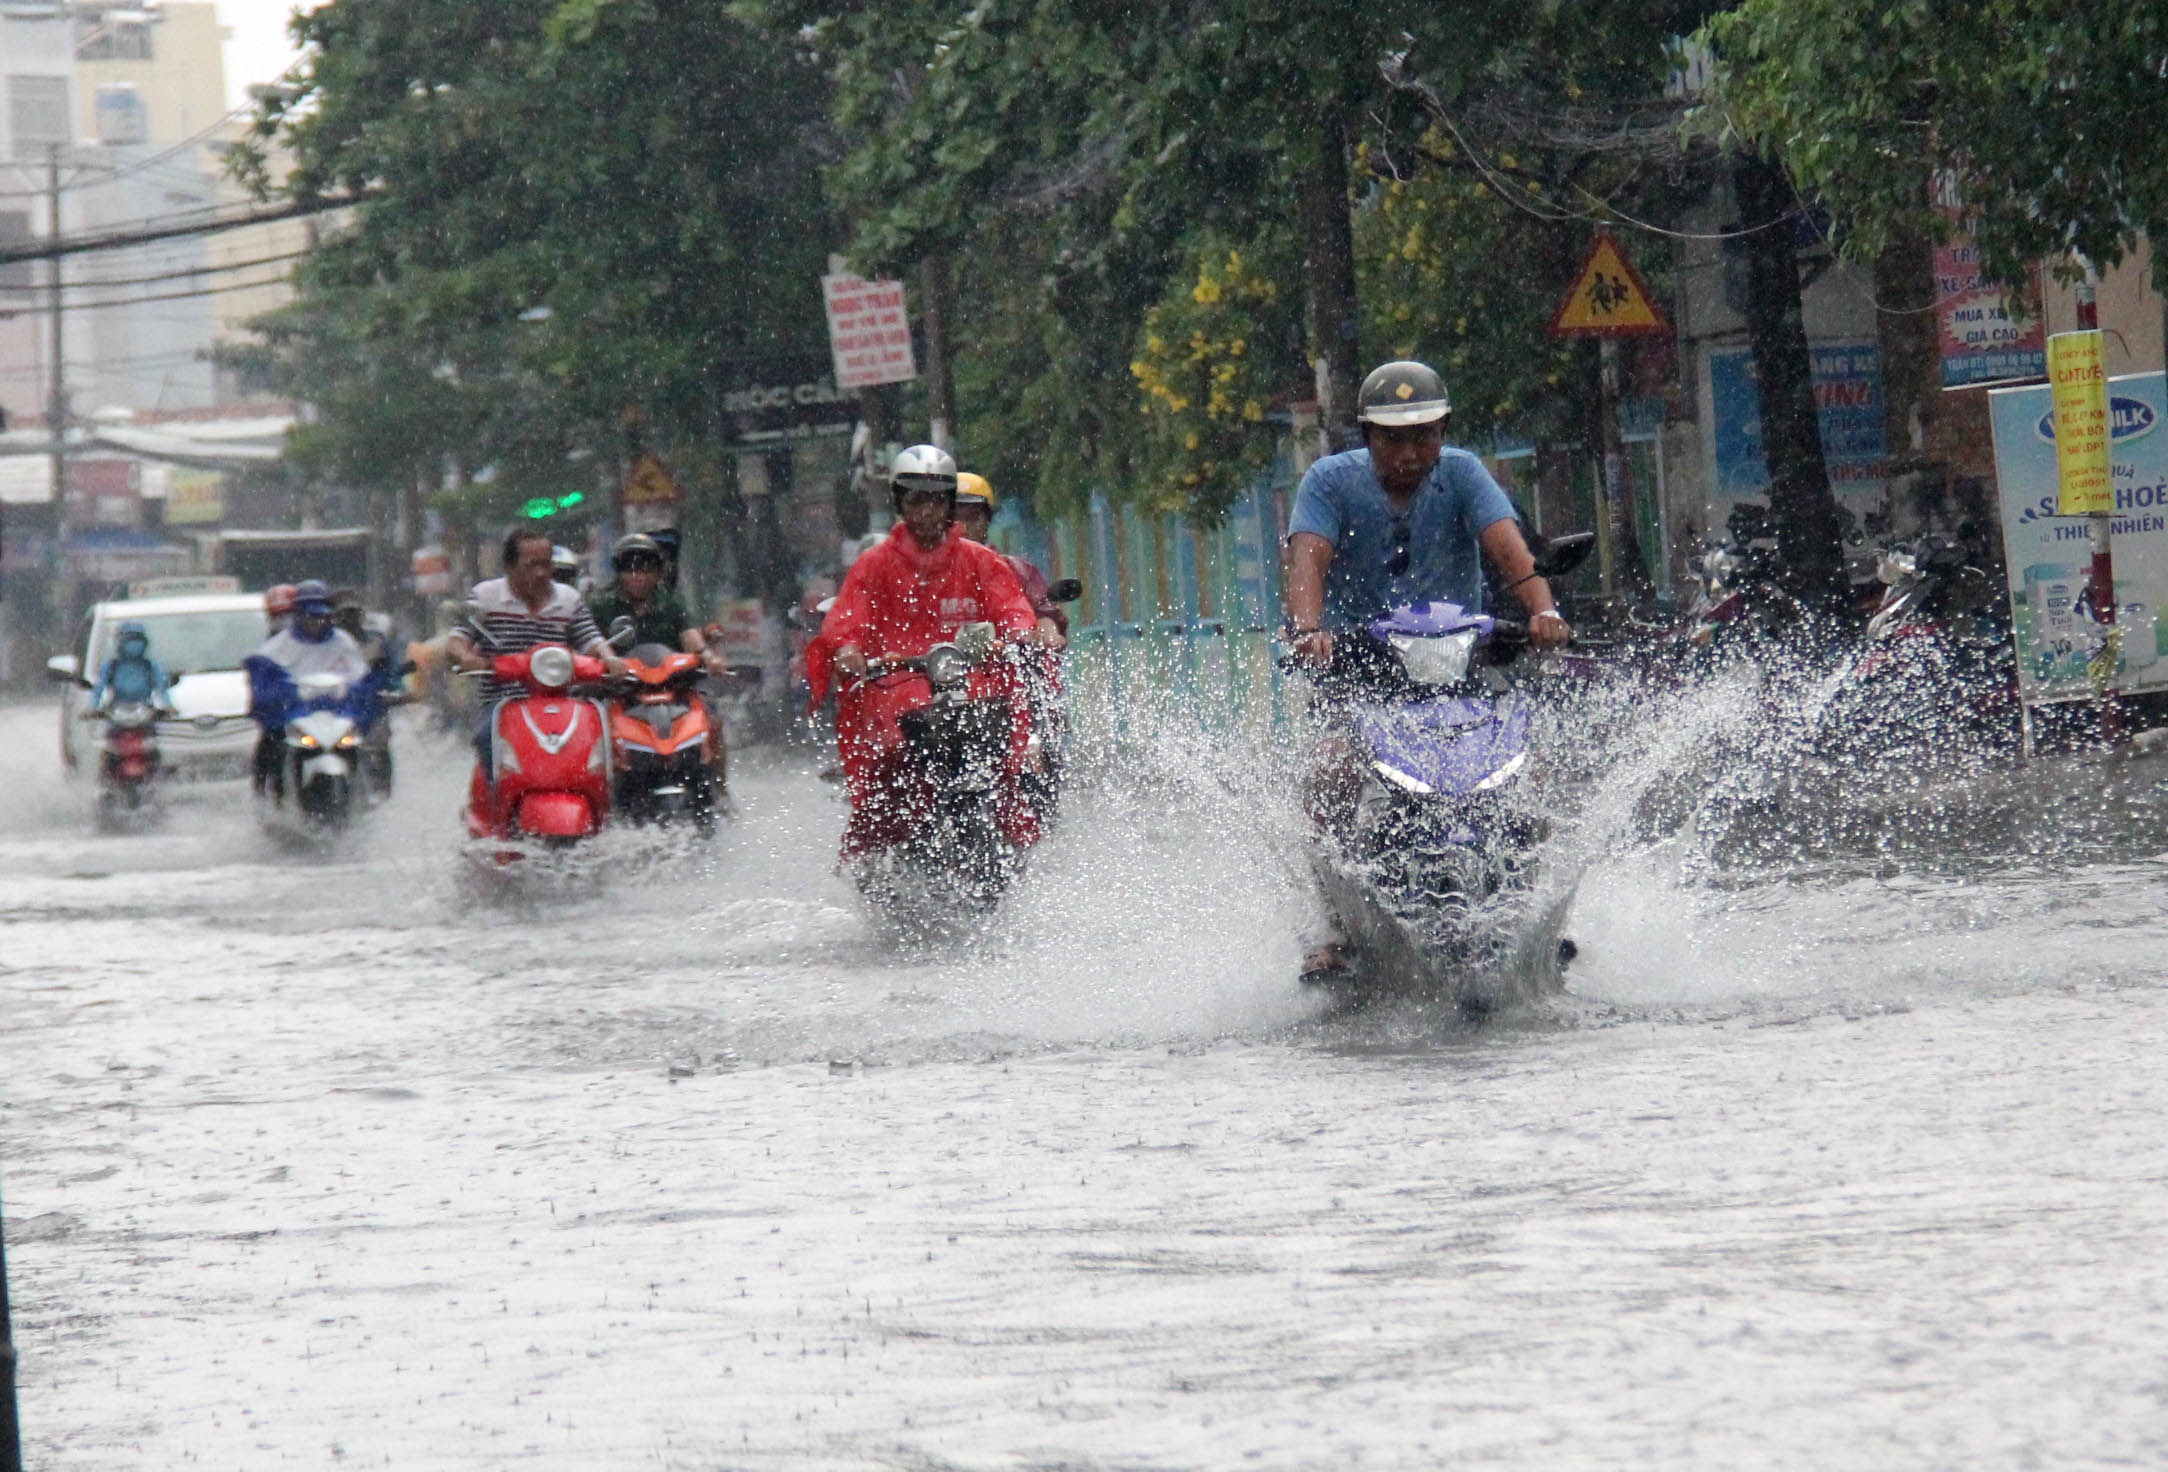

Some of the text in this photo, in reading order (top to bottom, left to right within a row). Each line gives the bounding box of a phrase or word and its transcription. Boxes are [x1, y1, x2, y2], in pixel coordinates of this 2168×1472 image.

[1955, 309, 1984, 322] MUA
[1992, 328, 2018, 341] CAO
[2111, 513, 2165, 535] NHIÊN
